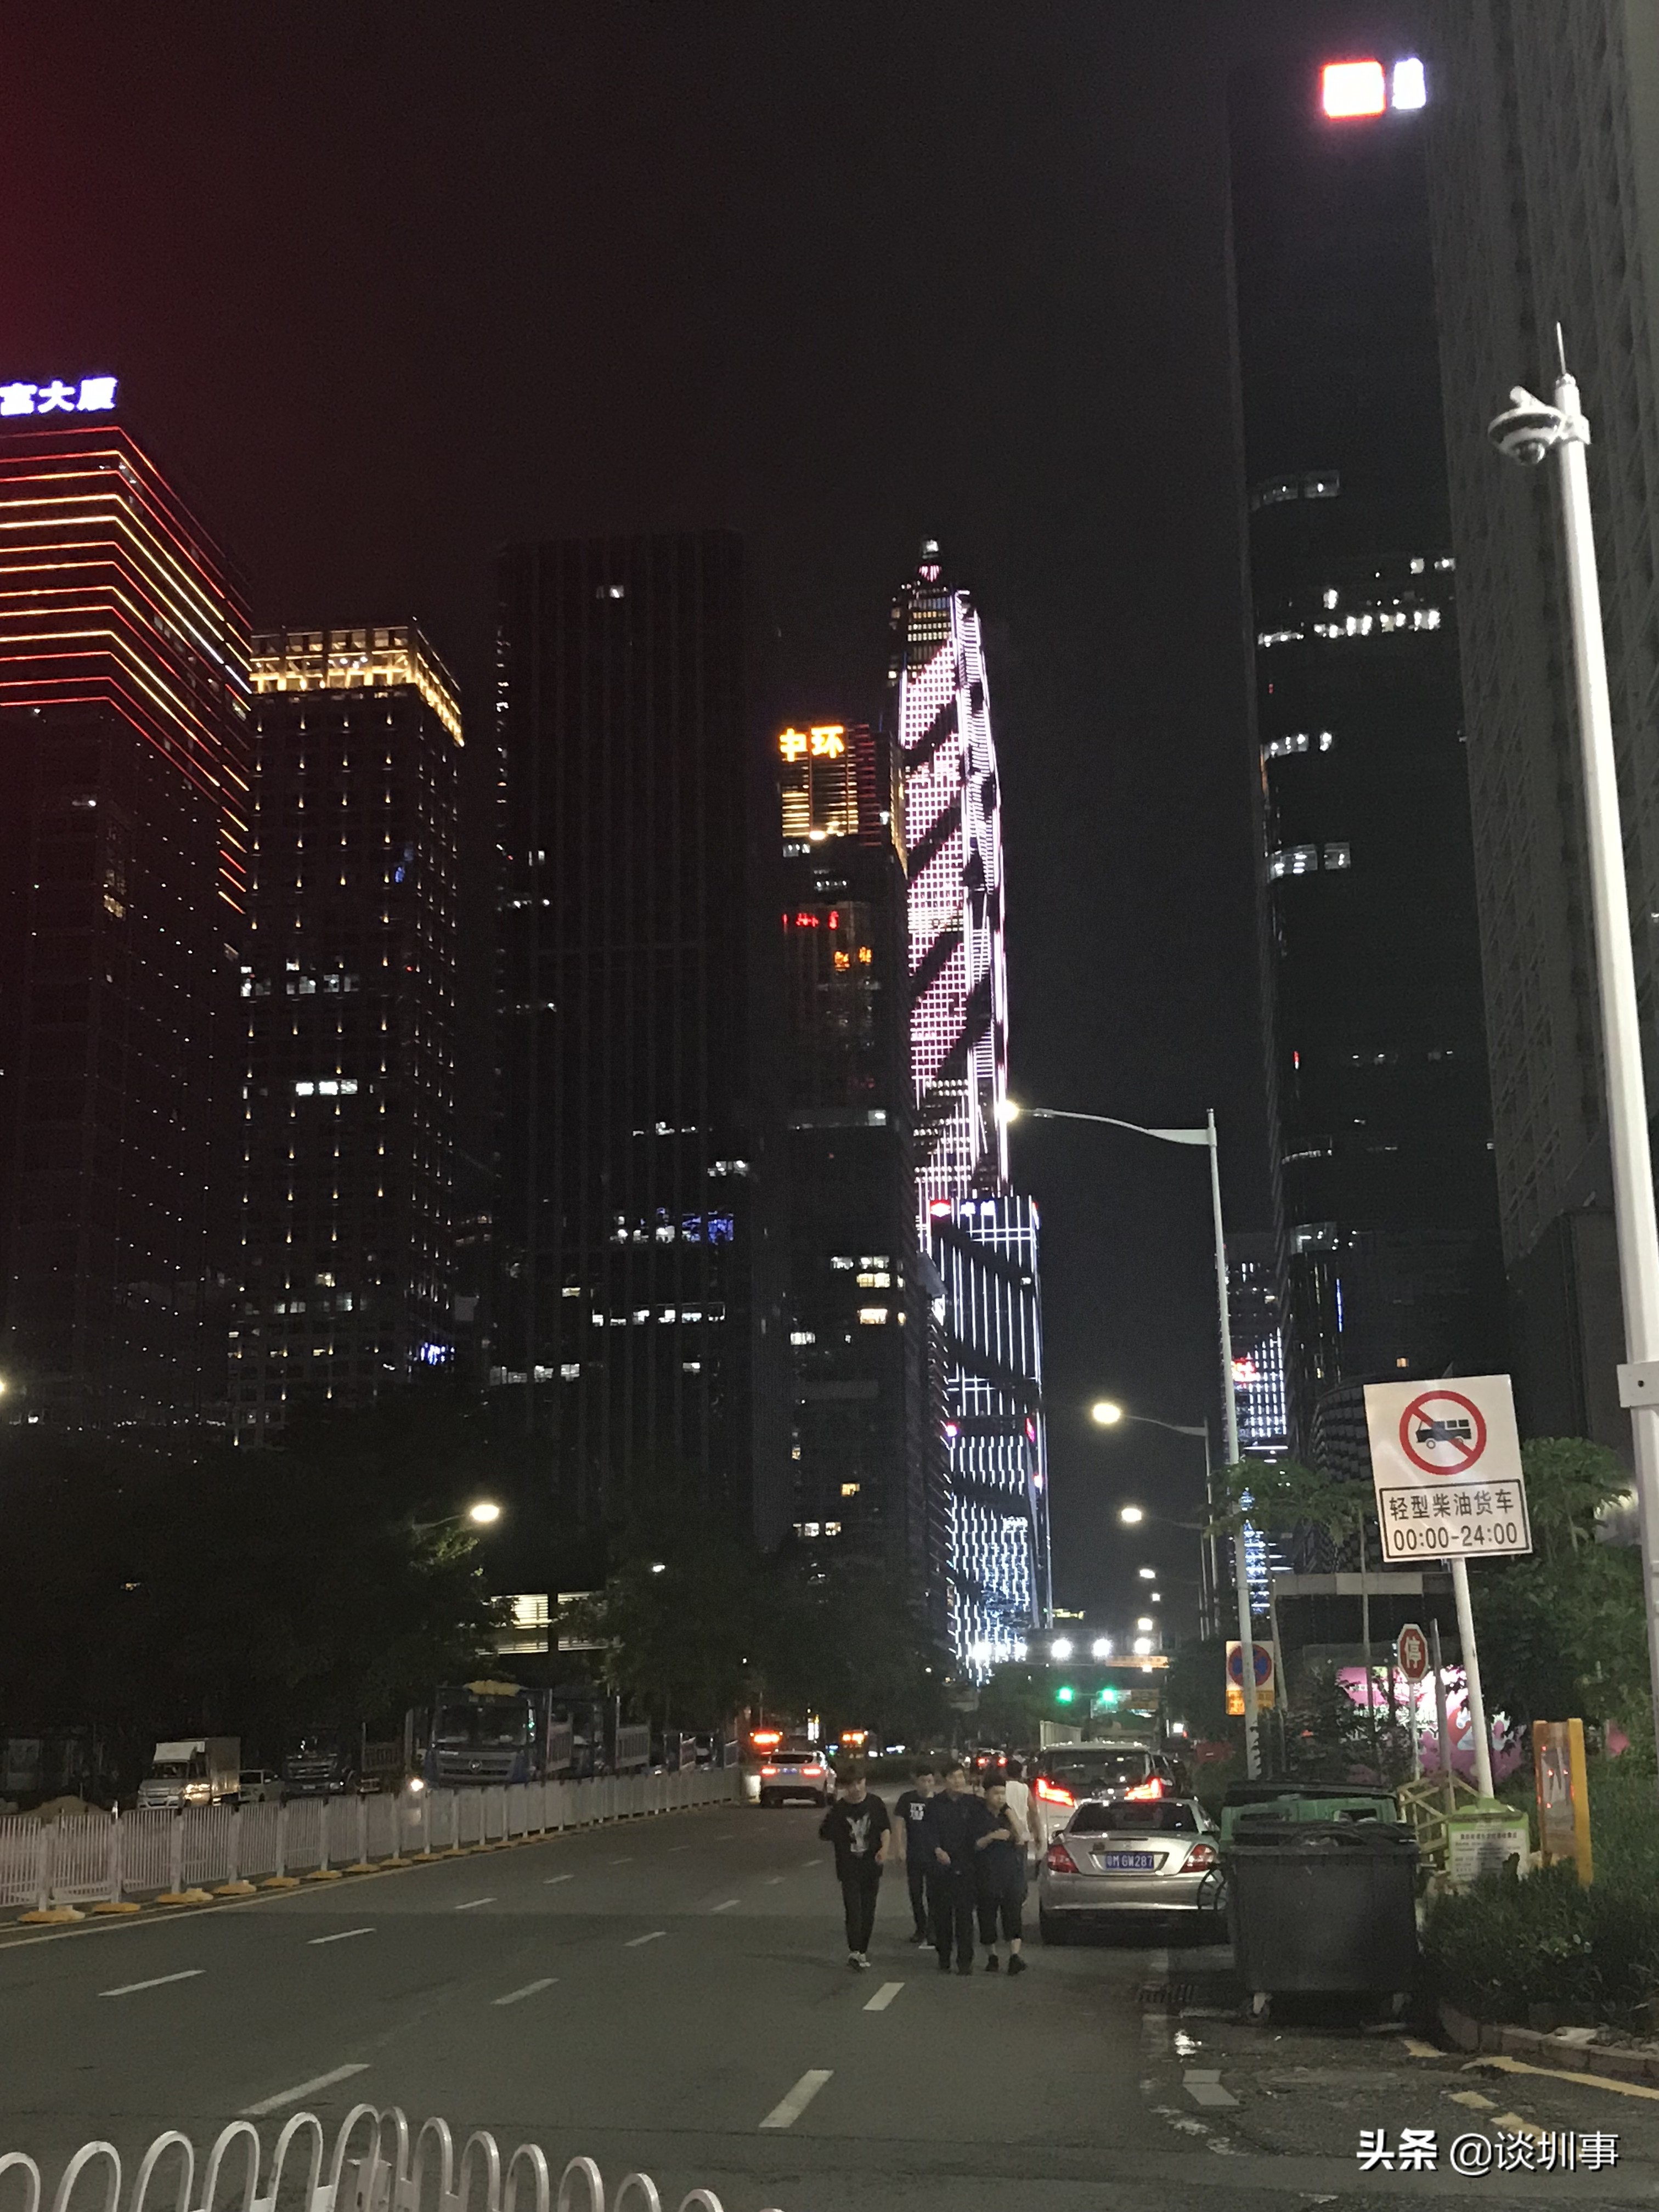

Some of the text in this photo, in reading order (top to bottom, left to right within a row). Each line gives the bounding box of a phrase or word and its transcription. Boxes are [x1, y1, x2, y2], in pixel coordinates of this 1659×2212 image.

[780, 726, 845, 762] 中环
[1389, 1488, 1514, 1521] 轻型柴油货车
[1393, 1522, 1517, 1551] 00:00-24:00
[1404, 1636, 1422, 1668] 停
